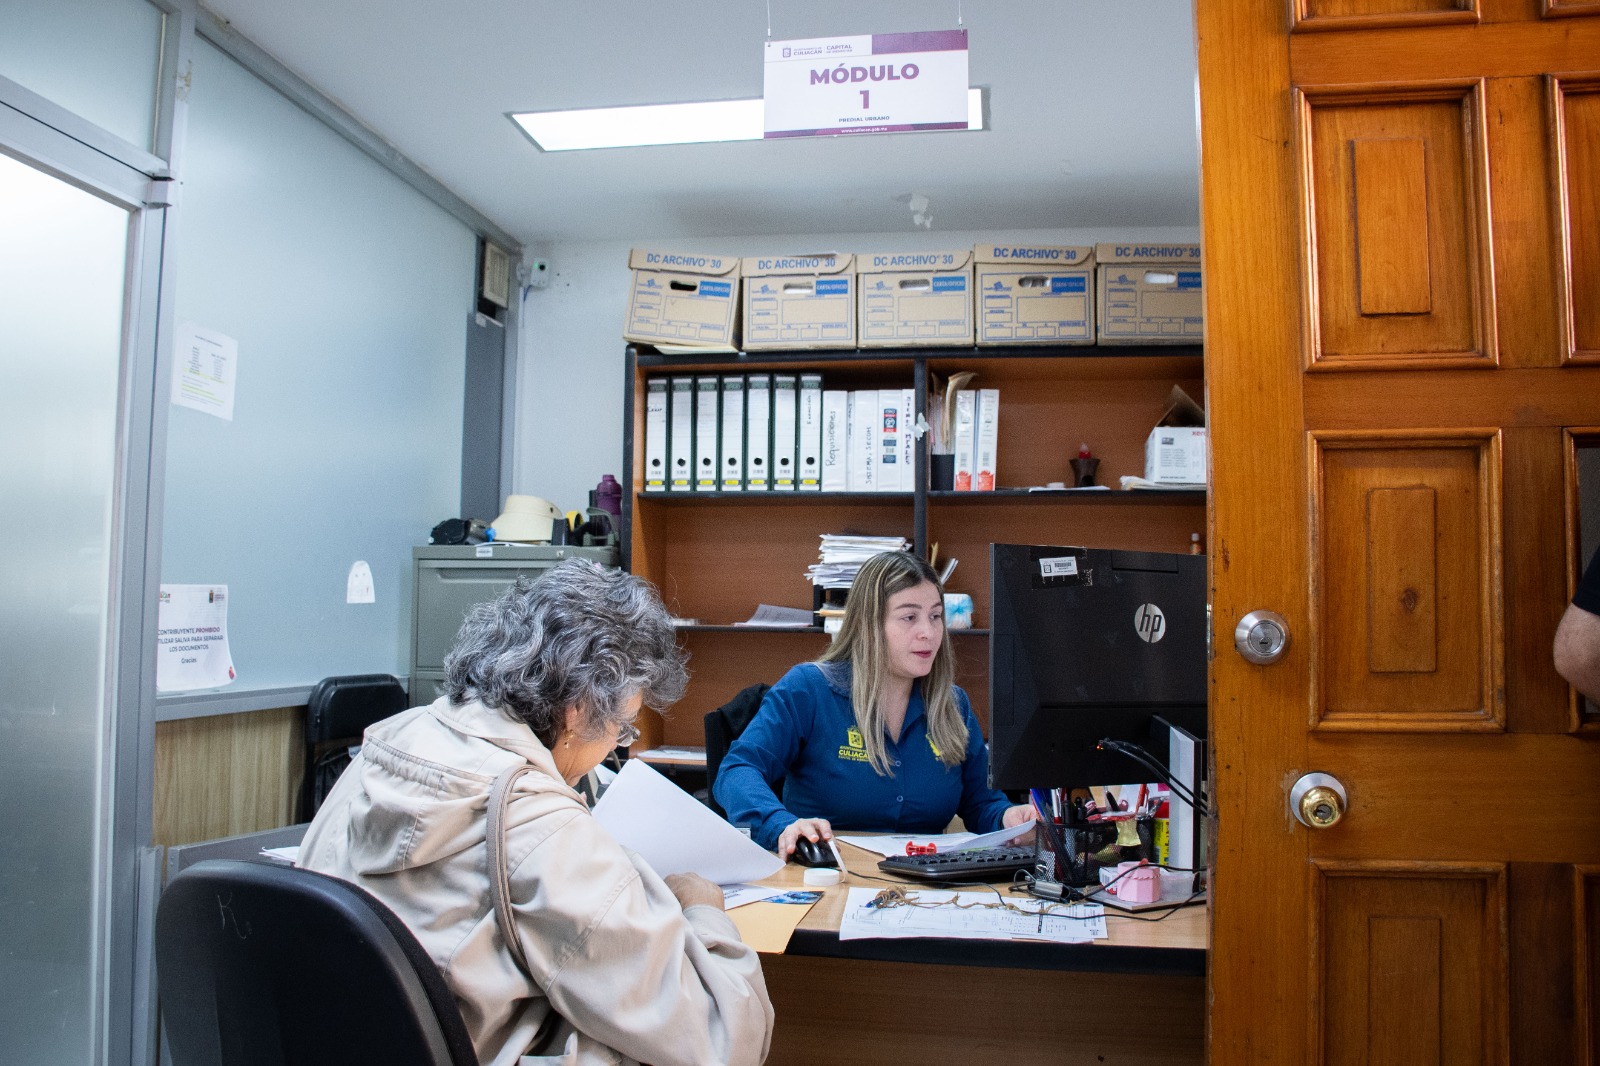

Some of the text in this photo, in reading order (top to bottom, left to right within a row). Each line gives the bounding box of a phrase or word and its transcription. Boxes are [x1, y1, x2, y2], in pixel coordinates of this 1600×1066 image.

[810, 63, 920, 85] MÓDULO
[859, 89, 870, 109] 1
[993, 247, 1008, 257] DC
[1065, 250, 1076, 259] 30
[1115, 247, 1131, 257] DC
[1188, 247, 1201, 257] 30
[647, 253, 660, 264] DC
[710, 259, 721, 269] 30
[758, 260, 772, 270] DC
[824, 257, 836, 267] 30
[874, 257, 887, 266] DC
[942, 255, 953, 264] 30
[1138, 603, 1162, 643] hp
[178, 644, 209, 652] DOCUMENTOS
[838, 749, 868, 759] CULIACA
